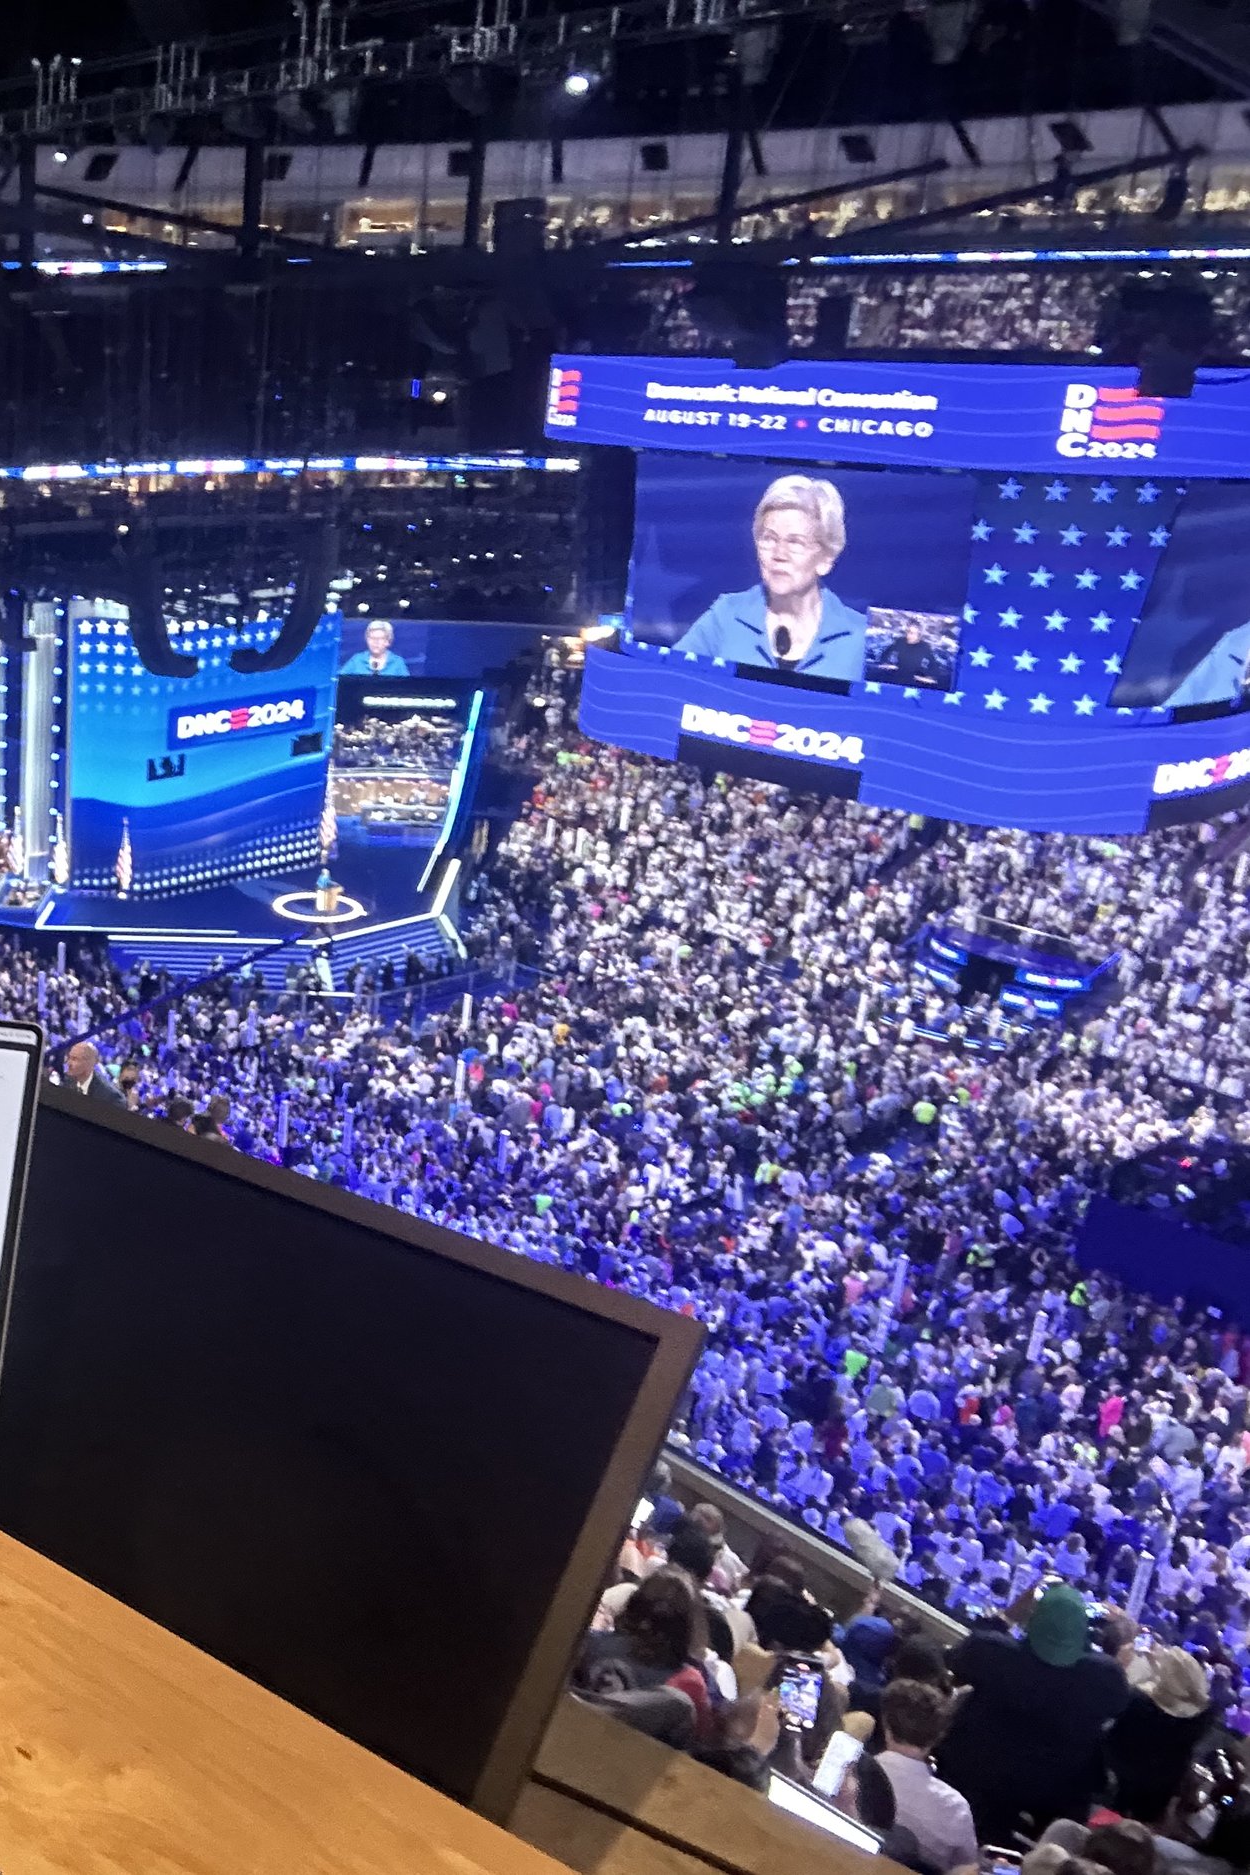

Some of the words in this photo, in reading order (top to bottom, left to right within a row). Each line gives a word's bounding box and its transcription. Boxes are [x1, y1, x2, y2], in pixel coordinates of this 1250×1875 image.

[643, 408, 722, 426] AUGUST
[727, 412, 787, 431] 19-22
[817, 417, 934, 438] CHICAGO
[1086, 441, 1158, 459] 2024
